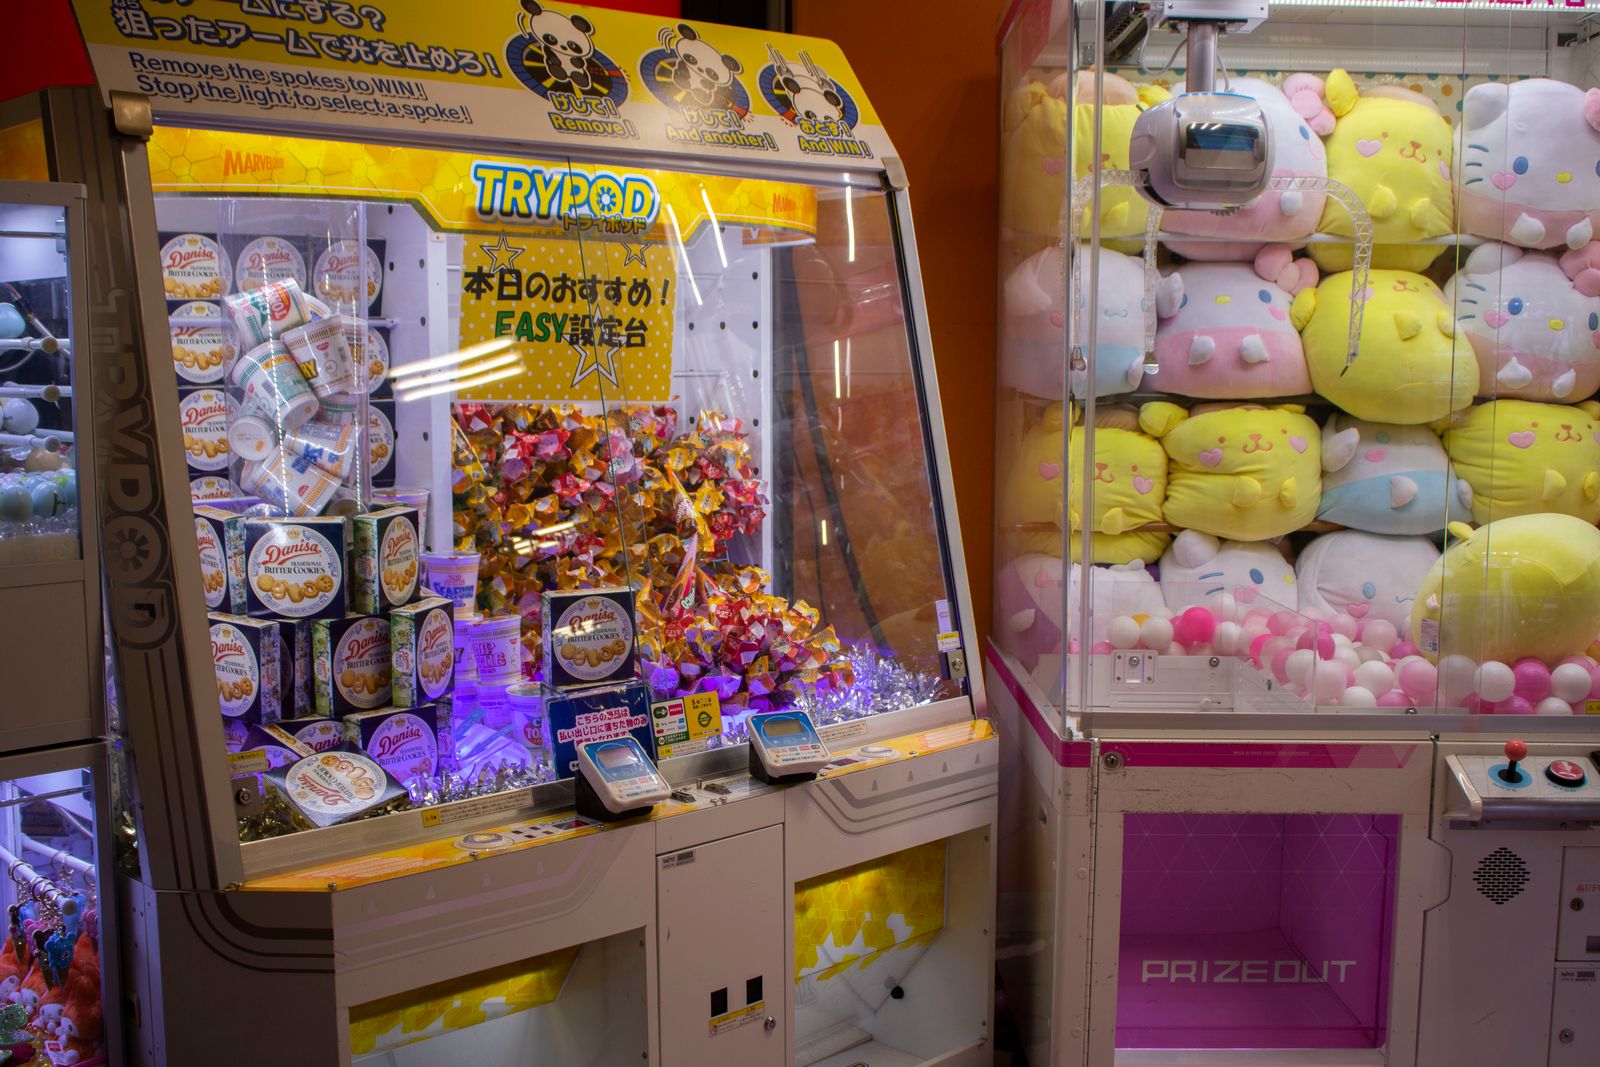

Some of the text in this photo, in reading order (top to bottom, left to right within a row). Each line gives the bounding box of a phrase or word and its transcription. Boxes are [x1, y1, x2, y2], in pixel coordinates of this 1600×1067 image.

[130, 51, 427, 100] Remove the spokes to WIN!
[137, 74, 473, 123] Stop the light to select a spoke!
[550, 93, 619, 118] けして！
[682, 108, 743, 129] けして！
[667, 125, 702, 144] And
[799, 137, 831, 155] And
[474, 164, 657, 219] TRYPOD
[563, 213, 647, 235] トライポッド
[166, 246, 216, 269] Danisa
[463, 266, 670, 307] 本日のおすすめ！
[182, 400, 233, 426] Danisa
[261, 539, 322, 566] Danisa
[264, 566, 326, 574] BUTTER COOKIES
[376, 726, 423, 758] Danisa
